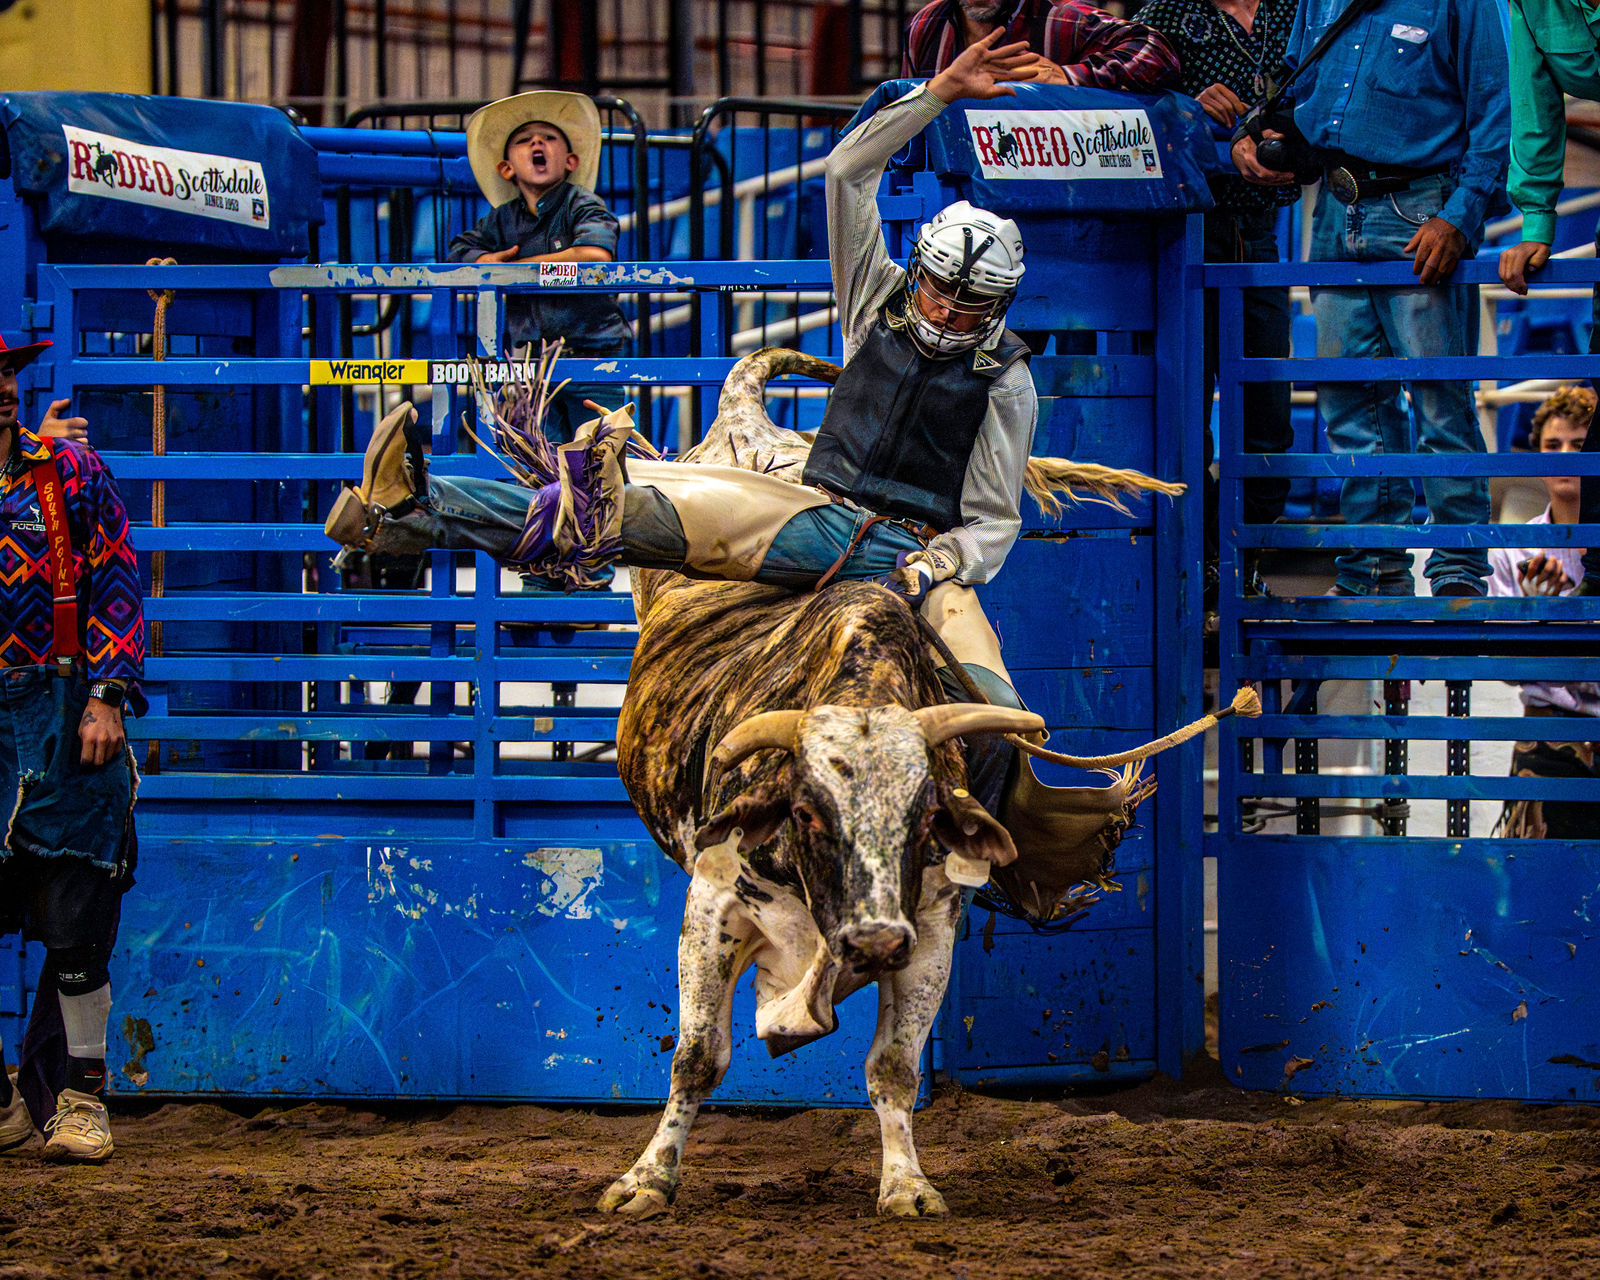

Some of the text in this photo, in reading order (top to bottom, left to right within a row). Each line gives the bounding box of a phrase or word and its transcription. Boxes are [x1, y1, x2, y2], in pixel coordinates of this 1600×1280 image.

[972, 117, 1150, 168] RDEO Scottsdale
[69, 140, 264, 200] RDEO Scottsdale
[1099, 154, 1119, 167] SINCE
[204, 193, 224, 209] SINCE
[541, 263, 577, 277] RDEO
[329, 362, 406, 384] Wrangler
[43, 482, 69, 591] SOUTH POINT
